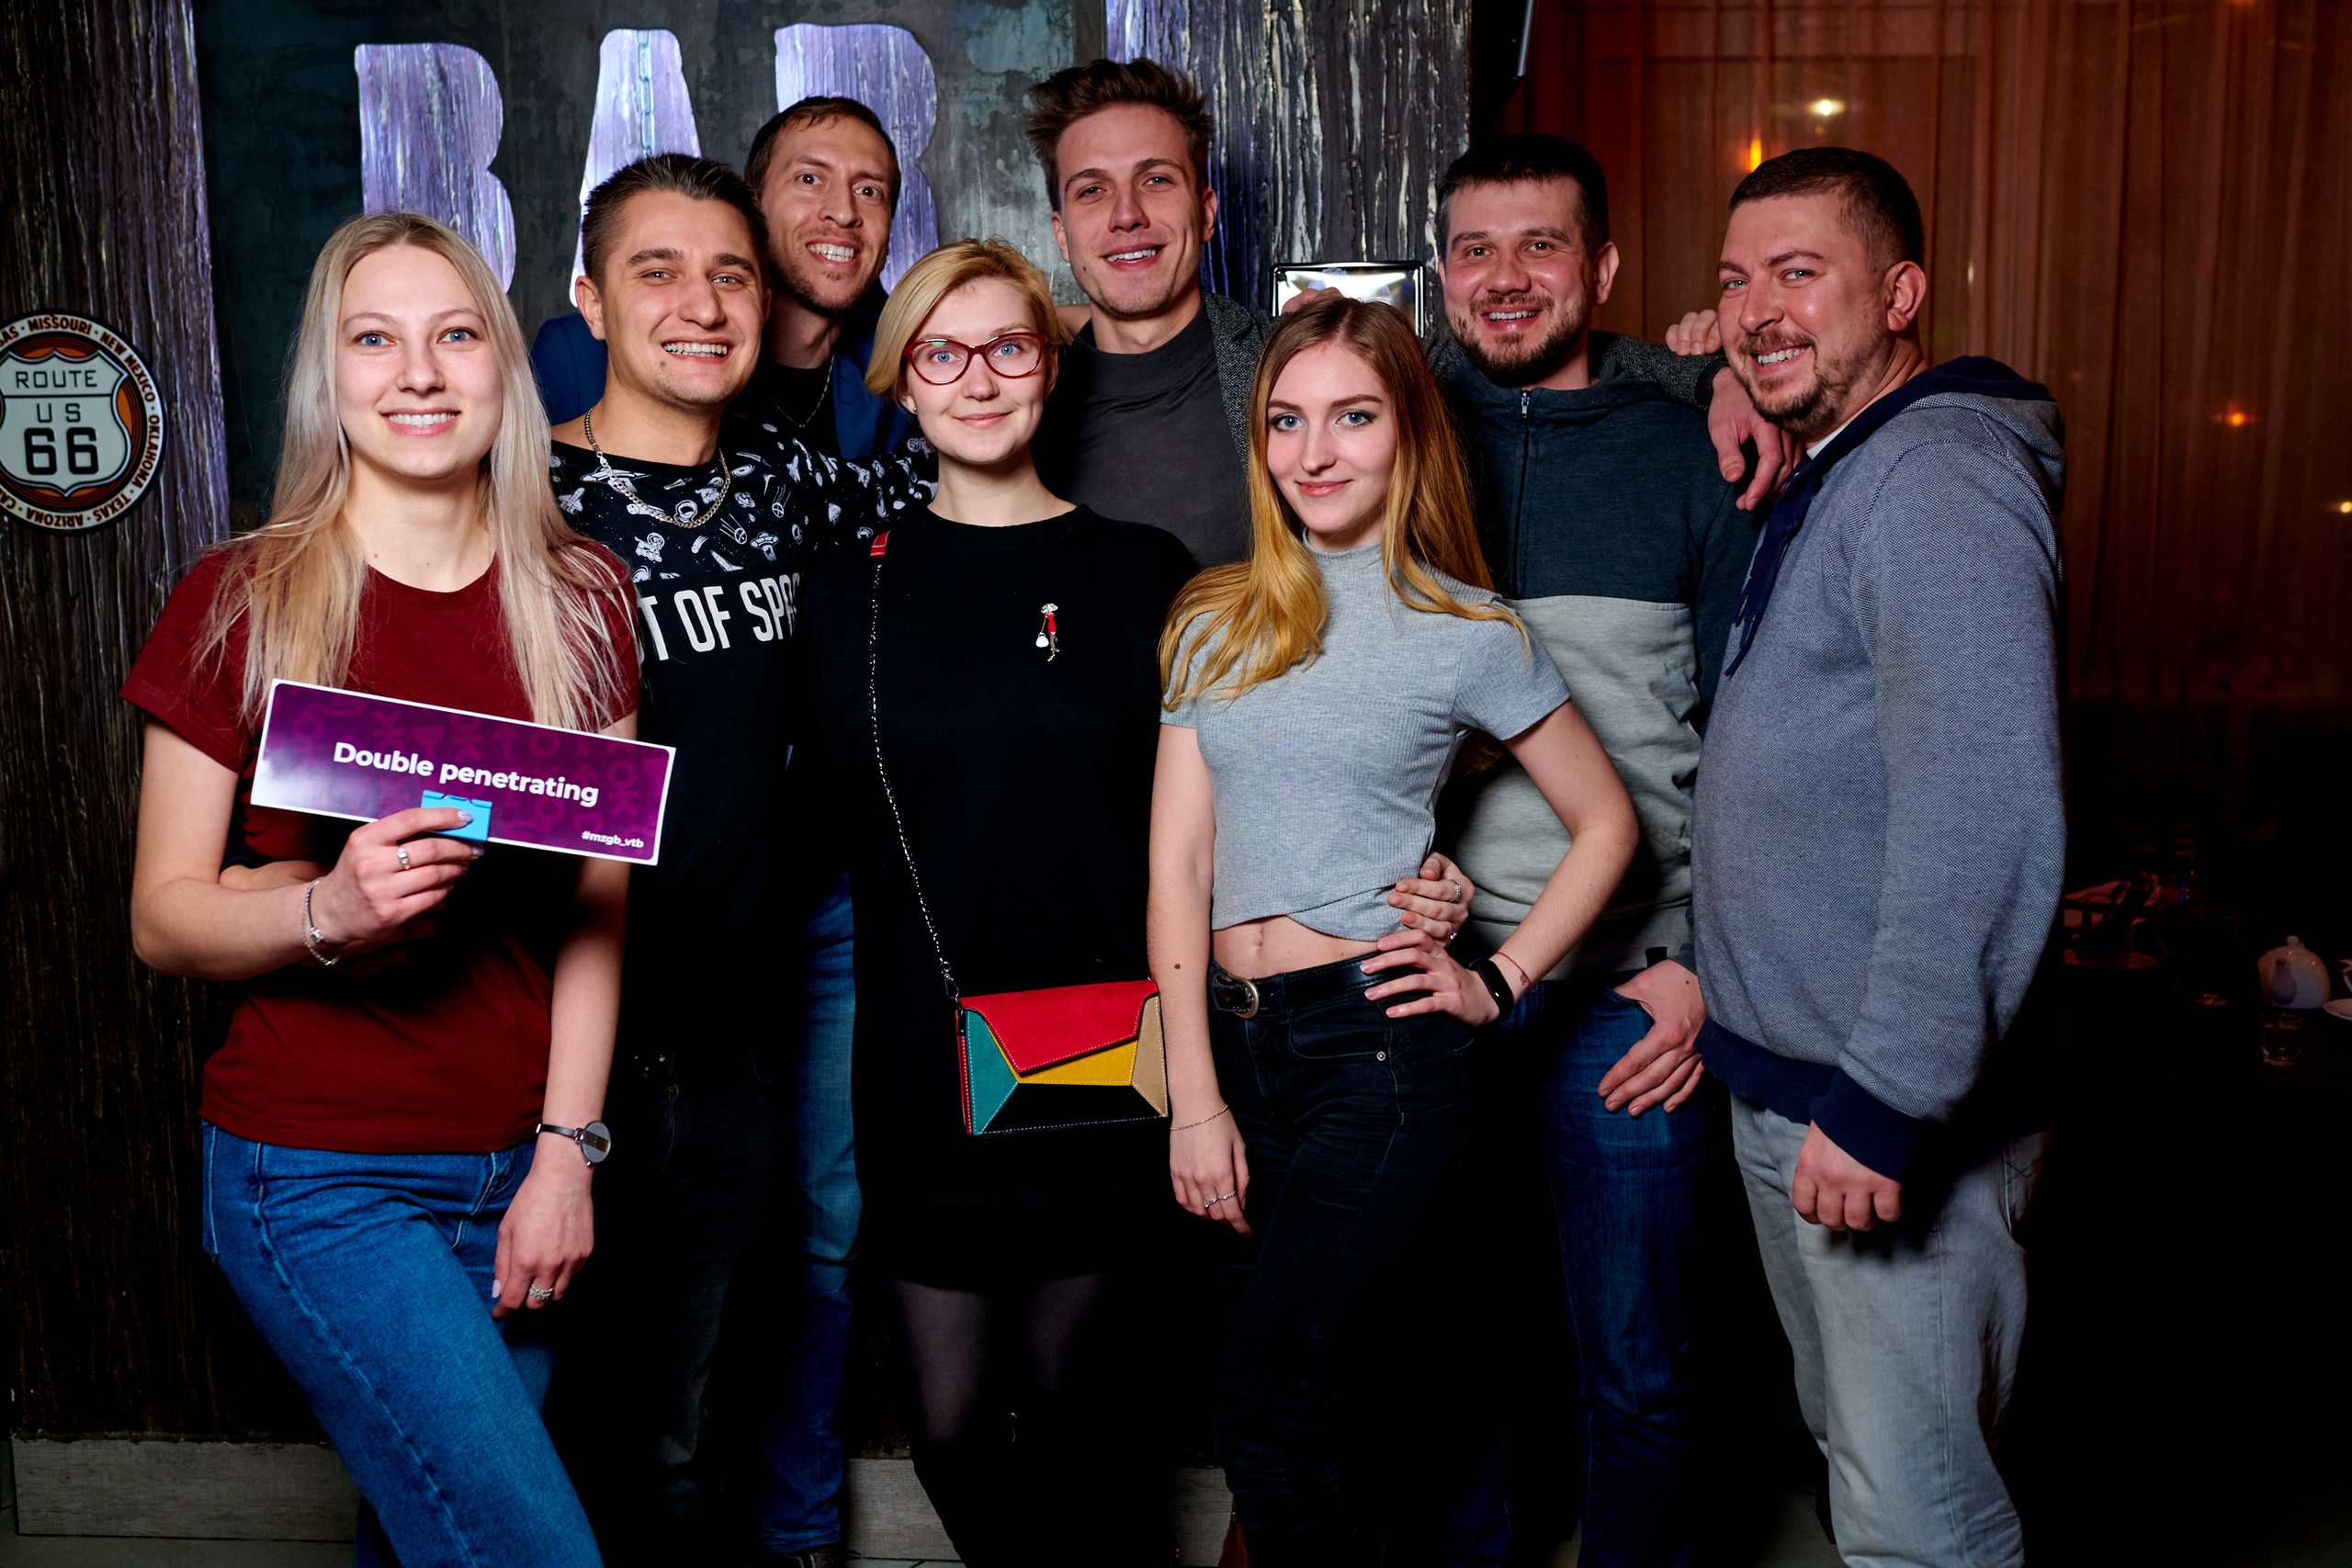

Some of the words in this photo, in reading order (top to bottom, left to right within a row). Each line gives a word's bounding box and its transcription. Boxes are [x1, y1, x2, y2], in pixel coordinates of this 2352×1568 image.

[28, 316, 93, 336] MISSOURI
[99, 331, 127, 355] NEW
[16, 369, 97, 389] ROUTE
[123, 354, 155, 402] MEXICO
[24, 427, 99, 475] 66
[131, 414, 161, 489] OKLAHOMA
[26, 507, 84, 527] ARIZONA
[93, 492, 131, 523] TEXAS
[673, 585, 730, 653] OF
[333, 741, 435, 776] Double
[439, 762, 599, 807] penetrating
[581, 830, 644, 848] #mzgb_vtb
